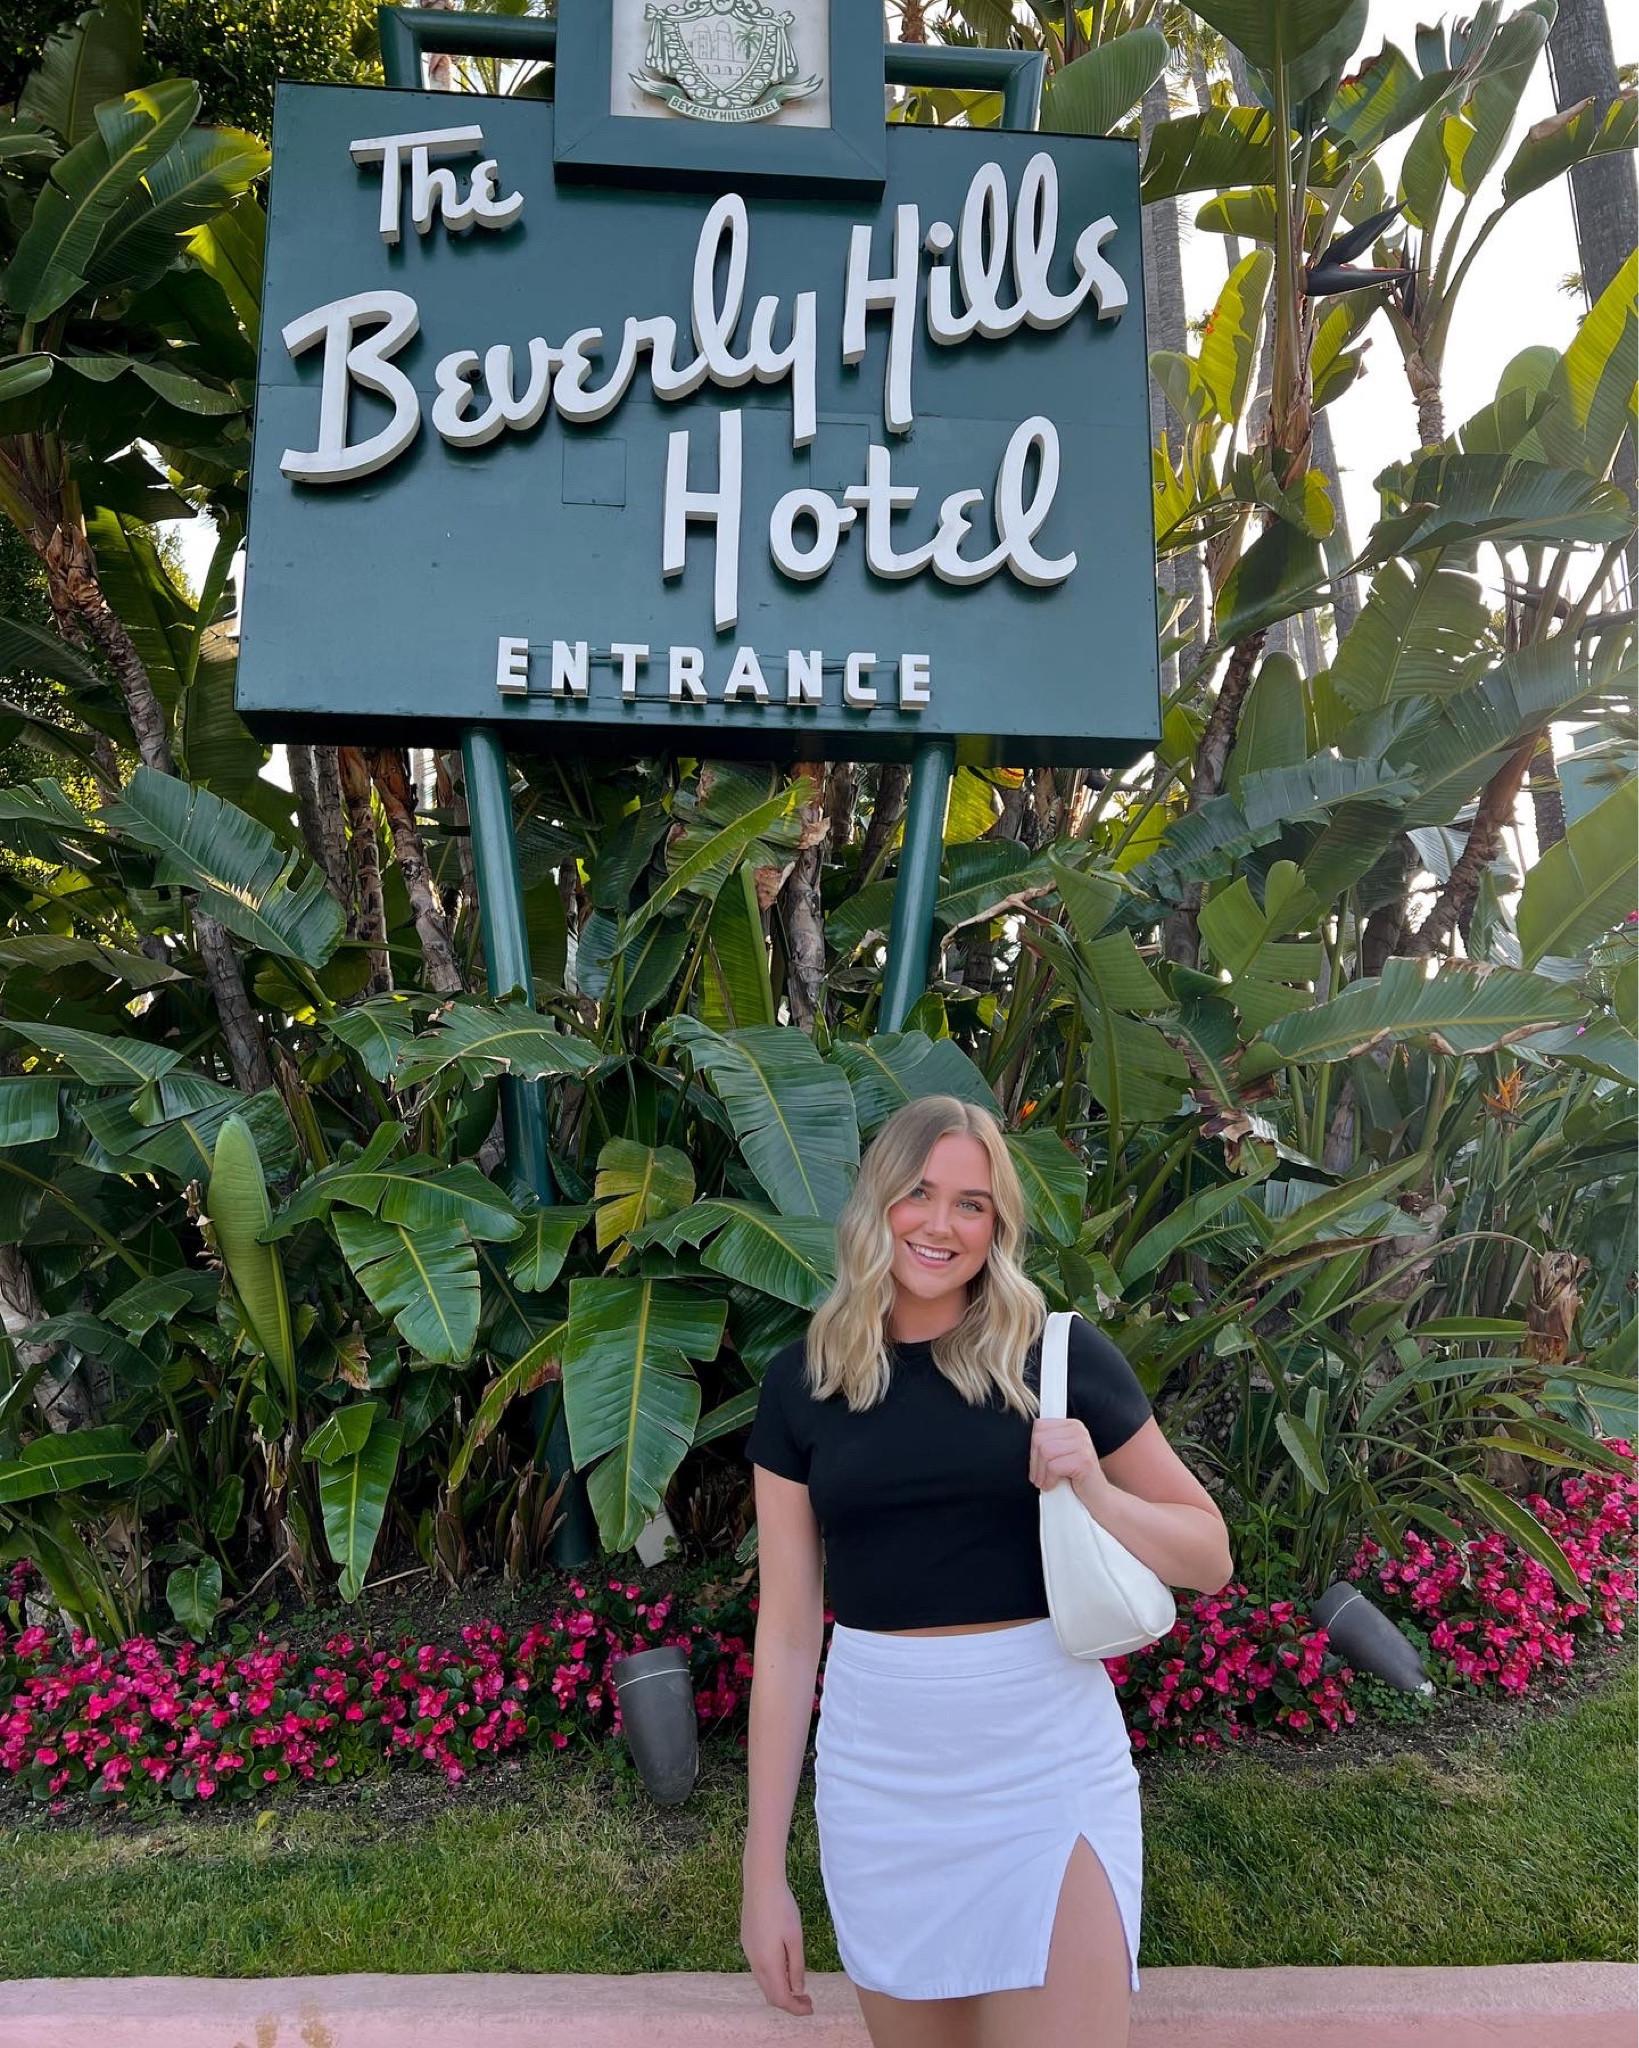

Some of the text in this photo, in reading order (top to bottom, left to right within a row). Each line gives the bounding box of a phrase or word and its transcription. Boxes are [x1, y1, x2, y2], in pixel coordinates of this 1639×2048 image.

[349, 124, 524, 244] The
[279, 152, 1128, 483] Beverly Hills
[662, 409, 1077, 632] Hotel
[496, 636, 931, 710] ENTRANCE
